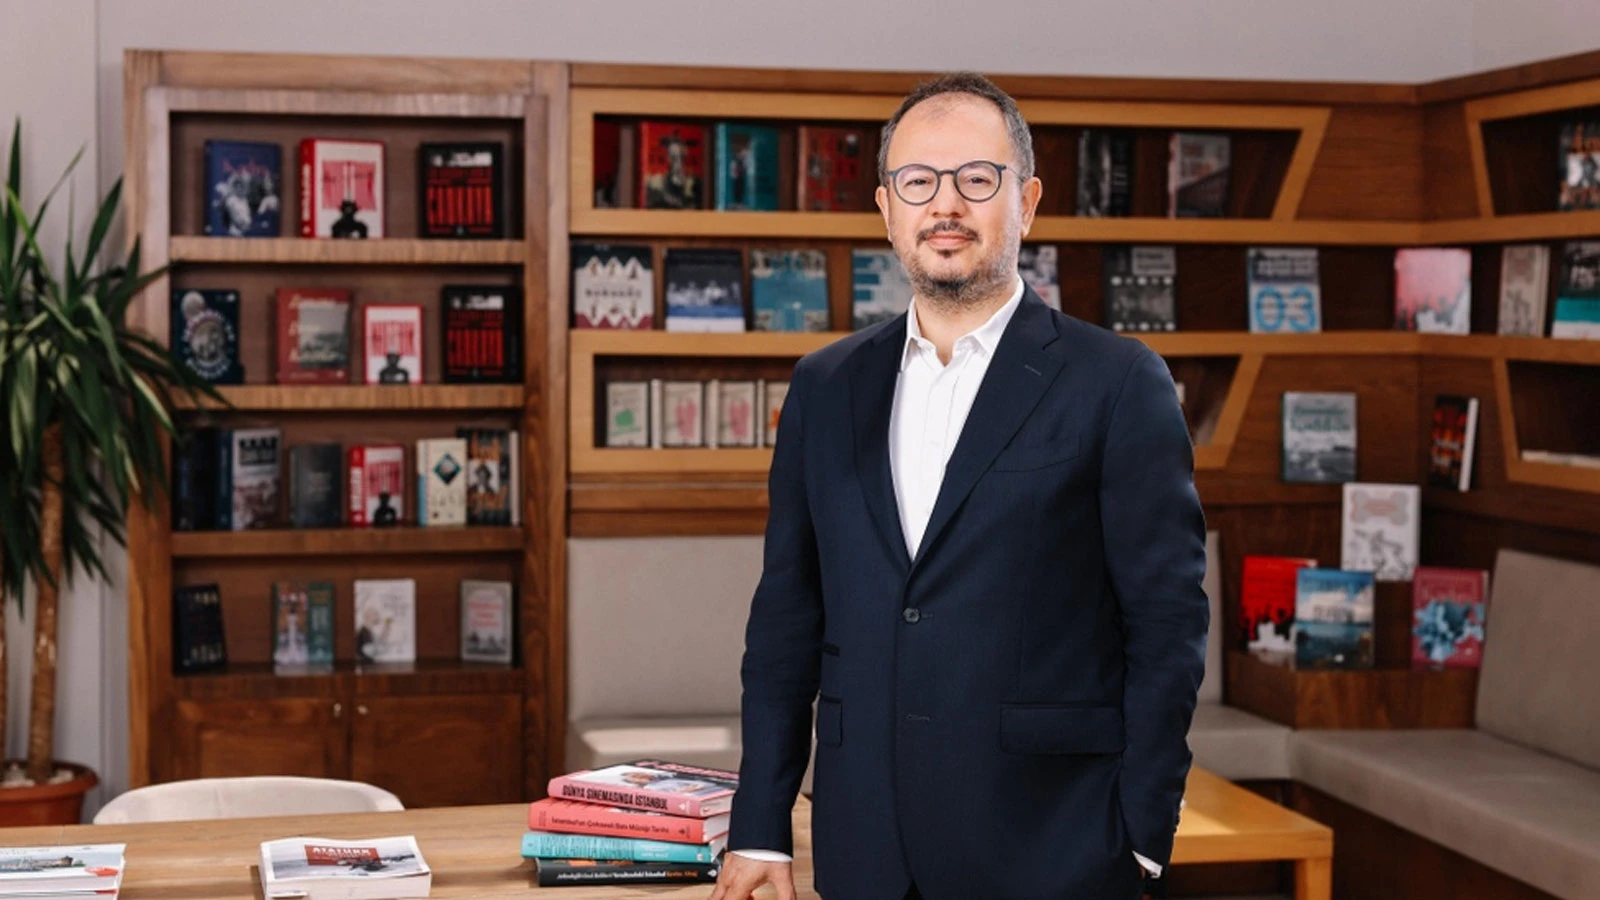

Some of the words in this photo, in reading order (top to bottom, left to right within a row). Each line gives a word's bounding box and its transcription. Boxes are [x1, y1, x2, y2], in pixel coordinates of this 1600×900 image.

[1255, 285, 1316, 332] 03
[562, 784, 585, 798] DÜNYA
[586, 787, 634, 805] SİNEMASINDA
[635, 791, 668, 810] İSTANBUL
